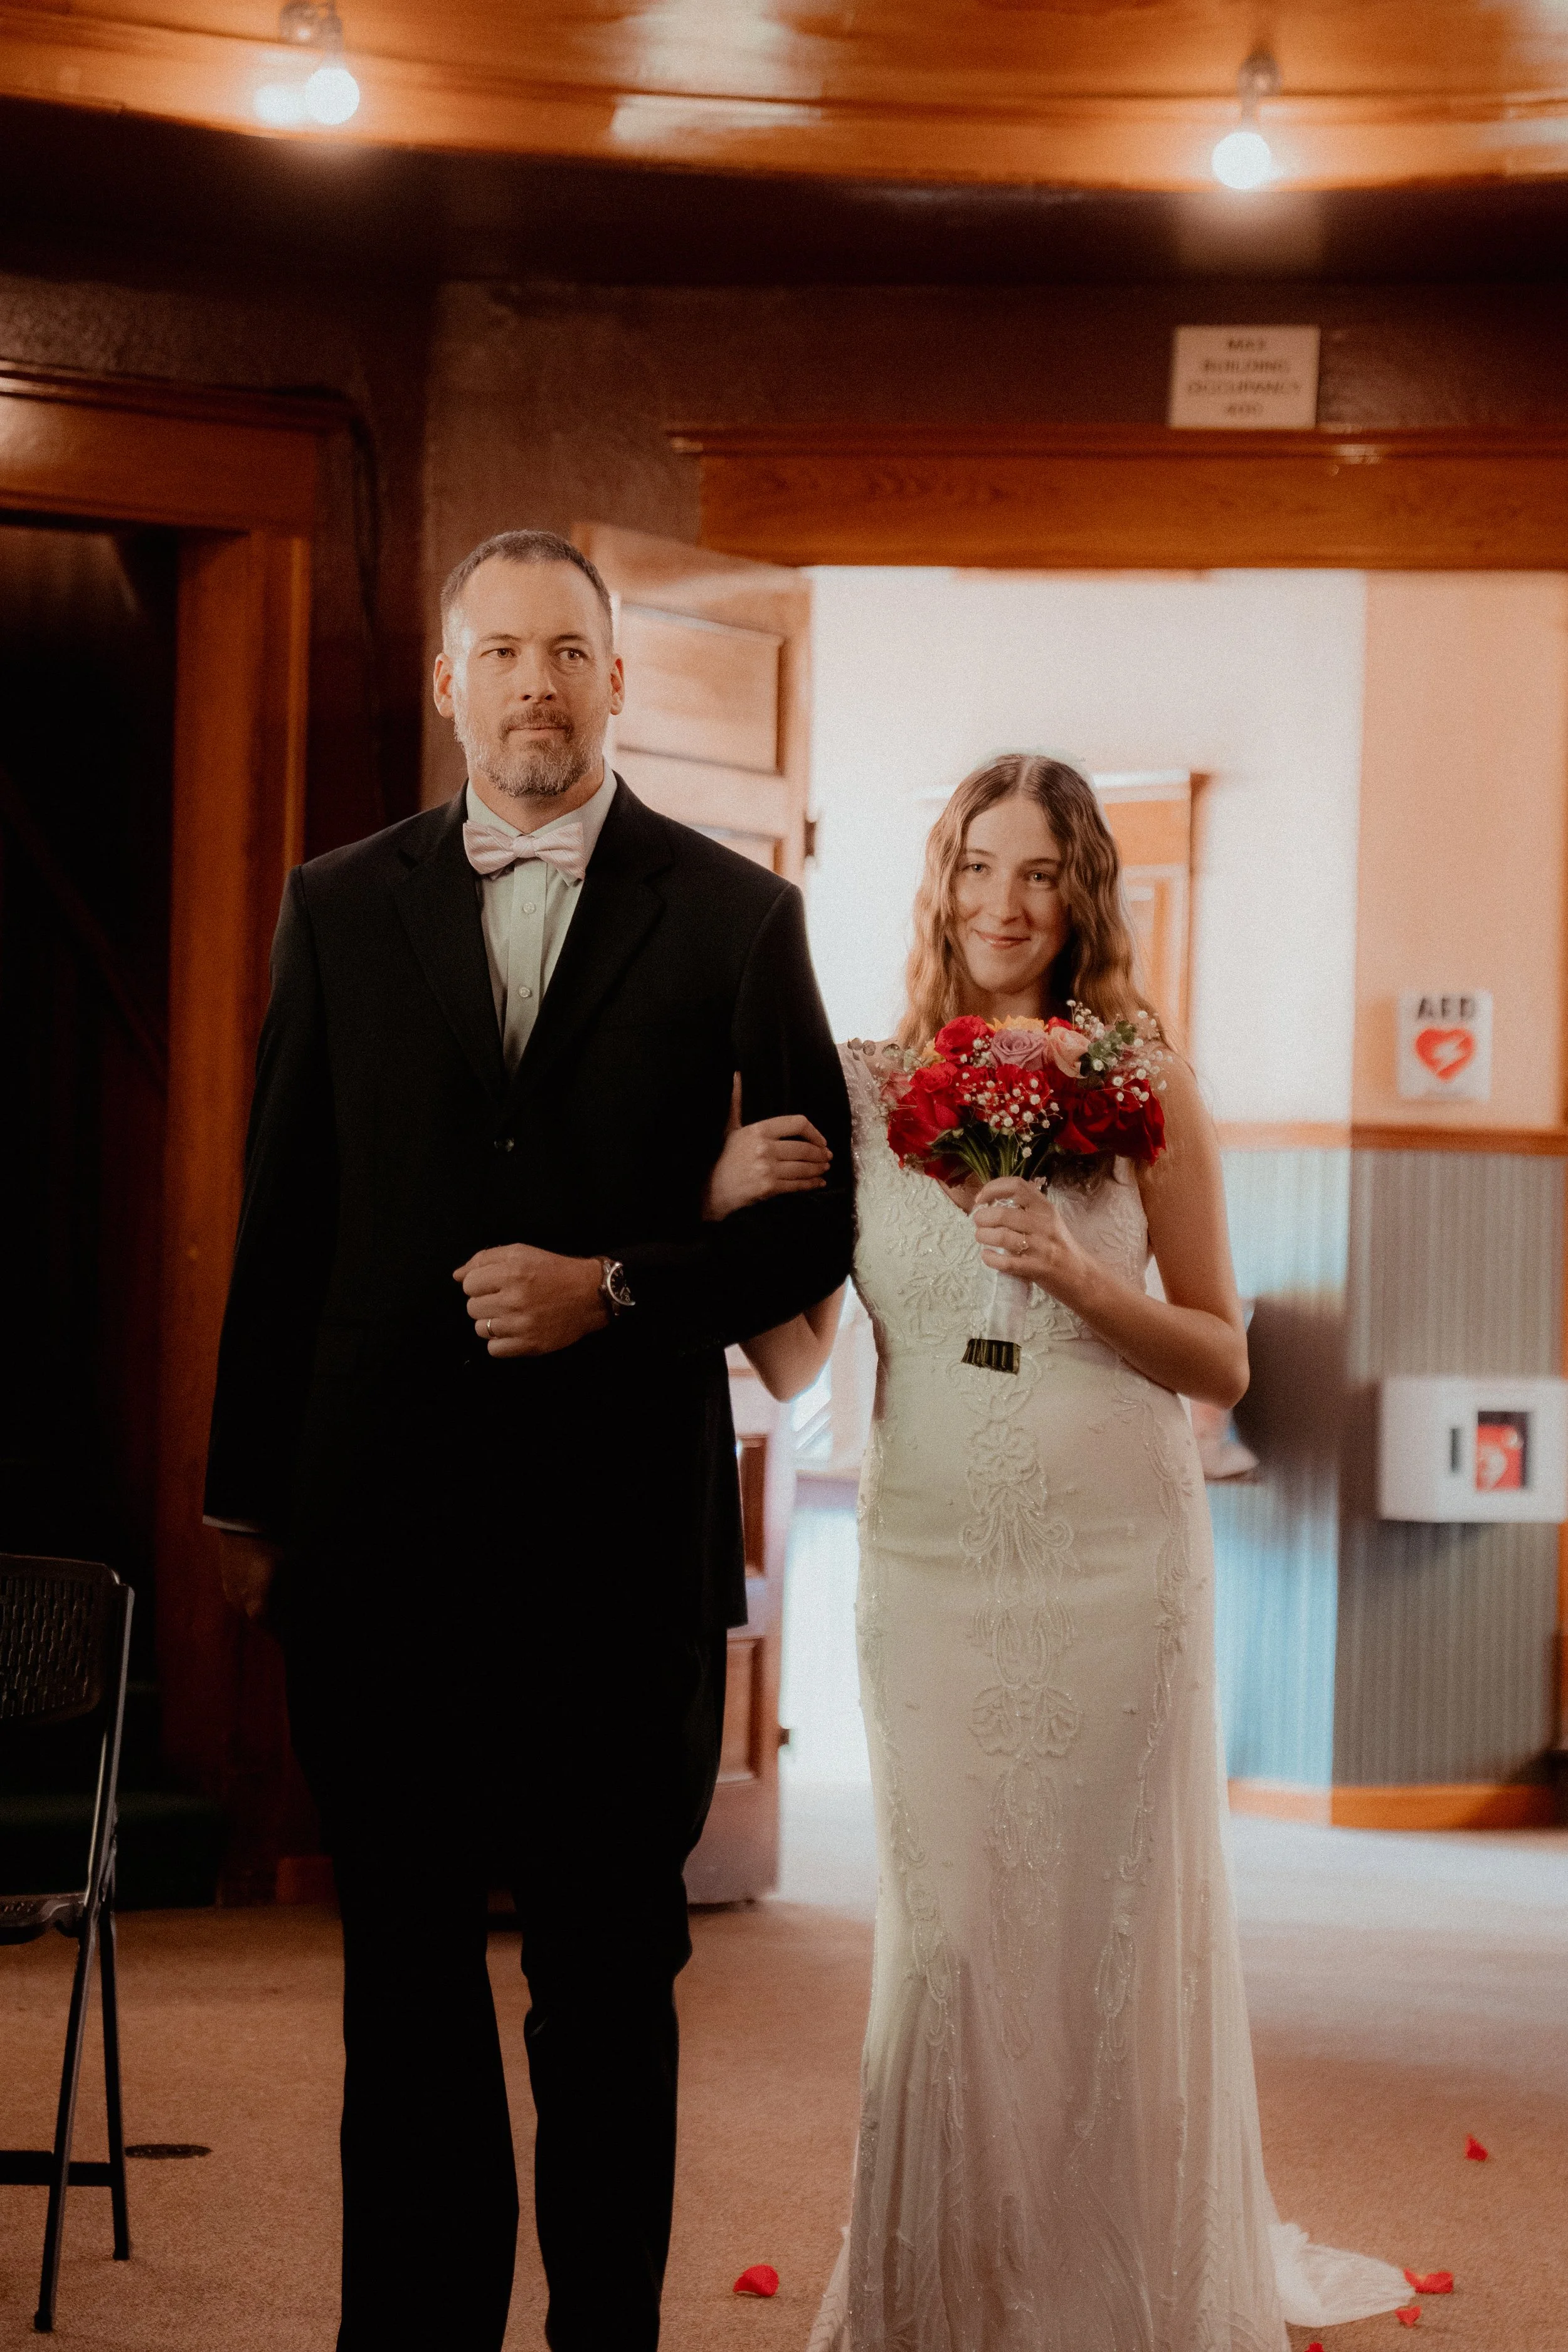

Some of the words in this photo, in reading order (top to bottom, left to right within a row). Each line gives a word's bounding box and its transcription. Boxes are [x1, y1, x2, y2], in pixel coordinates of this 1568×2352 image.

[1202, 359, 1290, 374] BUILDING
[1187, 379, 1301, 395] OCCUPANCY
[1417, 996, 1476, 1020] AED
